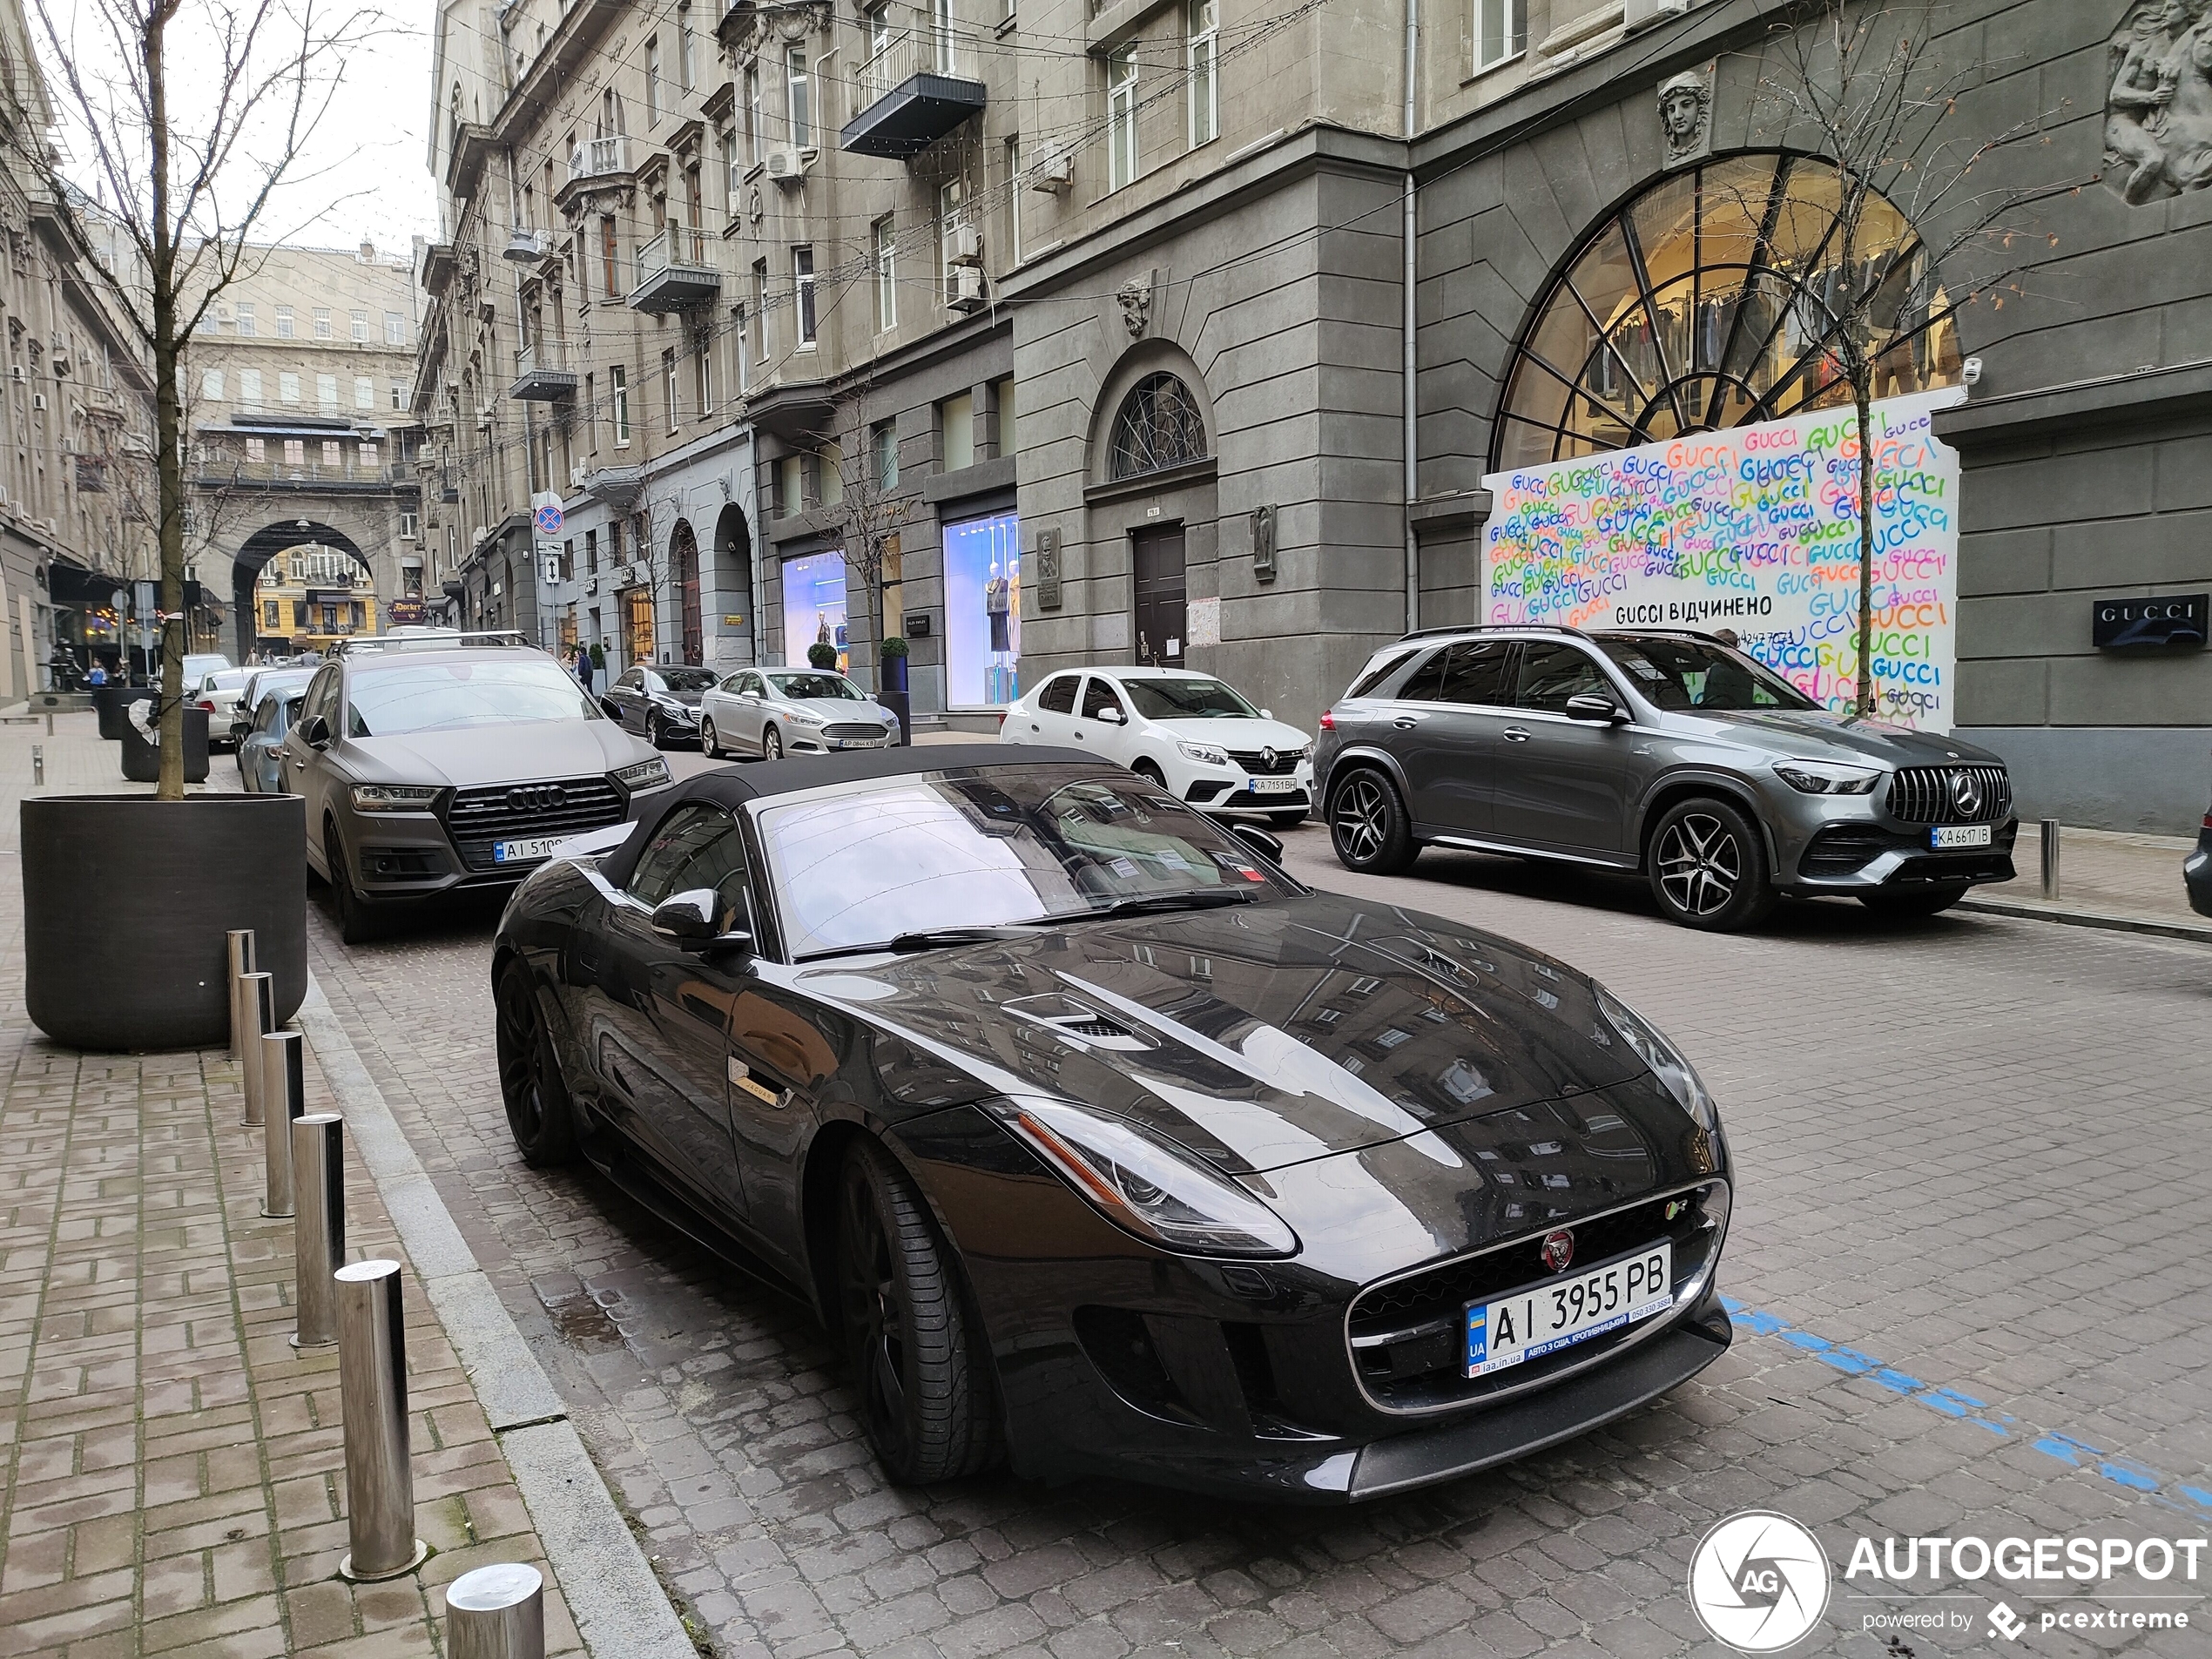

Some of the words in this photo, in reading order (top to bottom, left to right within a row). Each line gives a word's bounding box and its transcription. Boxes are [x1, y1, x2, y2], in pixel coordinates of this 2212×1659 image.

[1744, 429, 1797, 451] GUCCI
[1807, 411, 1886, 452] GUCI
[1667, 442, 1738, 470] GUCCI
[1623, 455, 1672, 485] GUCCI
[1740, 457, 1812, 484] GUCCI
[1513, 475, 1547, 498] GUCCI
[1662, 459, 1727, 504] GUCCI
[1875, 469, 1946, 497] GUCCI
[1521, 502, 1560, 515] GUCCI
[1691, 497, 1734, 521] GUCCI
[1769, 503, 1814, 523] GUCCI
[1491, 525, 1525, 542] GUCCI
[1779, 519, 1824, 540] GUCCI
[1799, 520, 1855, 545] GUCCI
[1645, 543, 1680, 562] GUCCI
[1675, 548, 1741, 579] GUCCI
[1730, 543, 1787, 566] GUCCI
[1889, 549, 1946, 567] GUCCI
[1611, 554, 1650, 574] GUCCI
[1644, 562, 1683, 580] GUCCI
[1543, 572, 1582, 594] GUCCI
[1578, 574, 1627, 603] GUCCI
[1706, 567, 1756, 591] GUCCI
[1491, 583, 1525, 600] GUCCI
[1529, 588, 1577, 616] GUCCI
[1888, 589, 1938, 607] GUCCI
[395, 602, 421, 611] Docker
[1569, 597, 1609, 627] GUCCI
[1616, 604, 1662, 624] GUCCI
[1669, 596, 1772, 623] ВІДЧИНЕНО
[2101, 604, 2193, 622] GUCCI
[1751, 643, 1818, 668] GUCCI
[1873, 658, 1940, 686] GUCCI
[1267, 781, 1284, 790] 7151
[1285, 780, 1296, 789] BH
[1939, 830, 1953, 844] KA
[1956, 829, 1976, 843] 6617
[1979, 828, 1987, 842] IB
[507, 844, 524, 858] AI
[746, 1084, 772, 1099] JAGUAR
[1493, 1298, 1533, 1350] AI
[1551, 1271, 1618, 1330] 3955
[1627, 1254, 1663, 1304] PB
[1632, 1309, 1643, 1320] 050
[1527, 1345, 1547, 1359] АВТО
[1572, 1314, 1627, 1342] КРОПИВНИЦЬКИЙ
[1469, 1342, 1485, 1359] UA
[1482, 1353, 1521, 1373] iaa.in.ua
